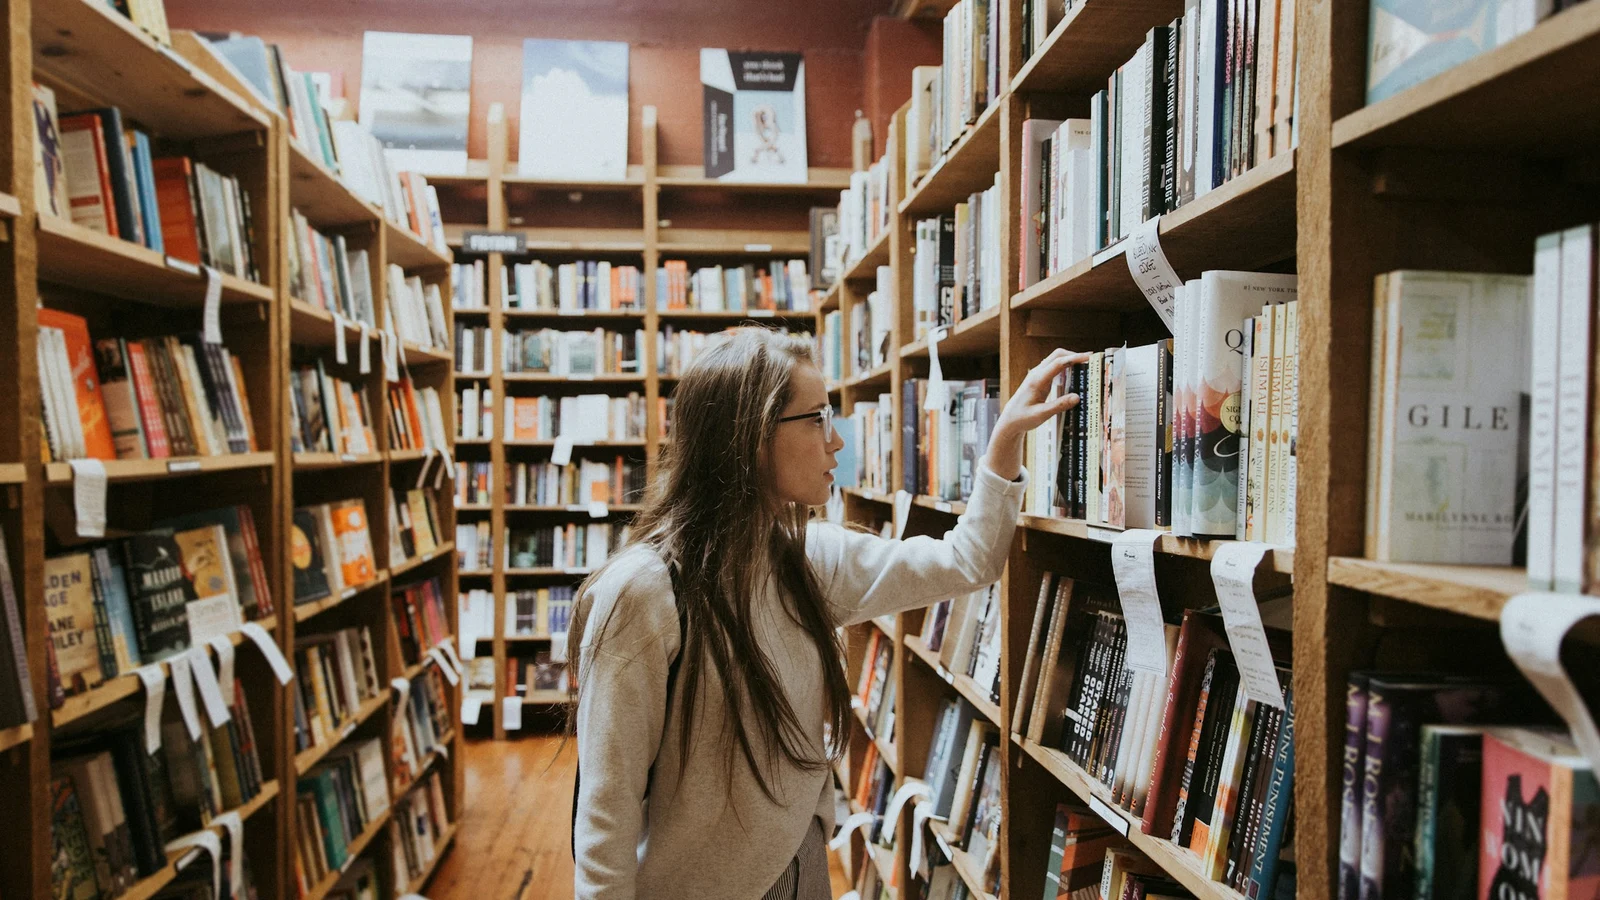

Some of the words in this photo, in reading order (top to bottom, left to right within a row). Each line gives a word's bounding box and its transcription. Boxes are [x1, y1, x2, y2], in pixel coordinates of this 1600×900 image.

[1168, 29, 1176, 73] THOMAS
[1166, 73, 1175, 121] PYNCHON
[1165, 127, 1174, 176] BLEEDING
[1165, 177, 1173, 204] EDGE
[1257, 356, 1268, 418] ISHMAEL
[1271, 357, 1281, 420] ISHMAEL
[1282, 355, 1293, 418] ISHMAEL
[1269, 450, 1277, 483] DANIEL
[1100, 648, 1113, 698] IMPERFECTIONISTS
[1105, 649, 1119, 700] IMPERFECTIONISTS
[1110, 651, 1123, 702] IMPERFECTIONISTS
[1172, 649, 1182, 680] Devil
[1074, 674, 1091, 734] OTARED
[1080, 677, 1097, 737] OTARED
[1086, 680, 1102, 741] OTARED
[1159, 691, 1174, 741] Jerusalem
[1253, 719, 1262, 748] RAKHA
[1261, 736, 1269, 755] CAME
[1268, 740, 1276, 759] CAME
[1152, 749, 1161, 776] NAOMI
[1343, 745, 1358, 809] ROSE
[1236, 780, 1251, 834] CROCODILES
[1362, 755, 1383, 822] ROSE
[1255, 768, 1285, 874] PUNISHMENT
